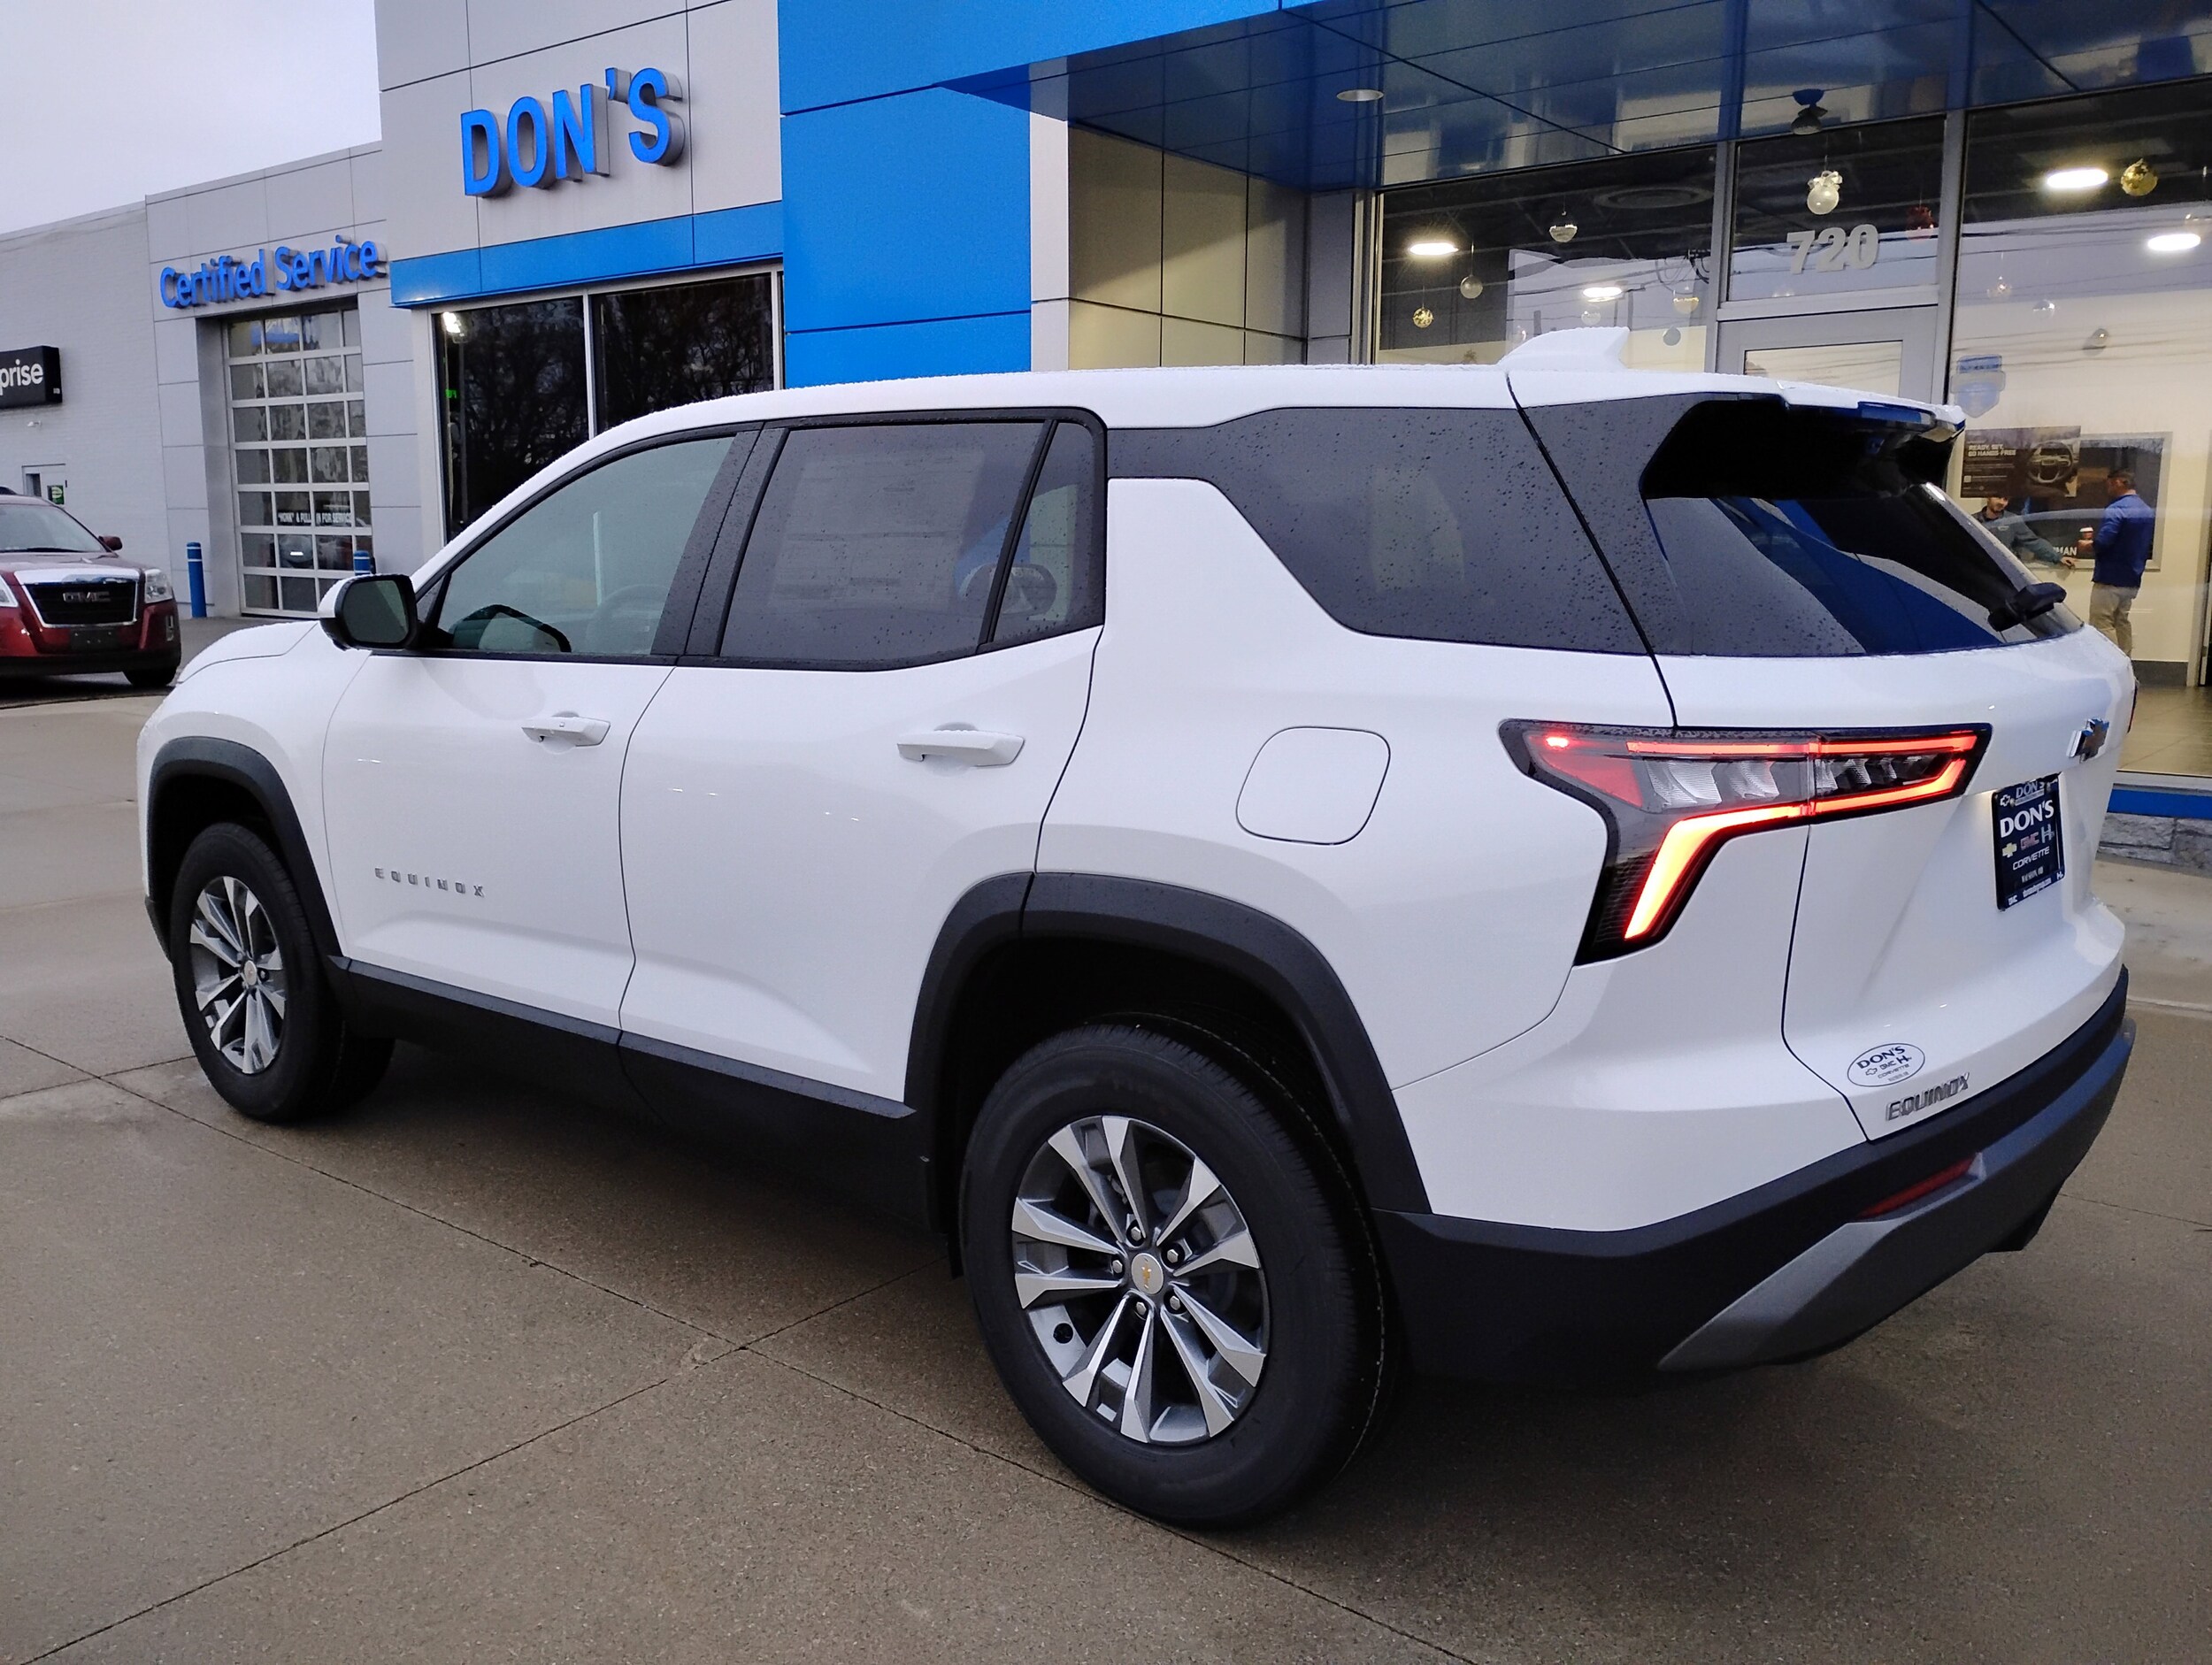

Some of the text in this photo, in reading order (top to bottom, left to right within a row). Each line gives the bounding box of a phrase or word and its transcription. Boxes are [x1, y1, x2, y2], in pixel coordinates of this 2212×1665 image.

[460, 67, 683, 196] DON'S
[1786, 224, 1879, 275] 720
[160, 234, 380, 308] Certified Service
[63, 591, 111, 602] GMC
[2000, 799, 2055, 838] DON'S
[2020, 832, 2039, 850] GMC
[2012, 846, 2050, 871] CORVETTE
[374, 867, 485, 898] EQUINOX
[1856, 1046, 1906, 1069] DON'S
[1879, 1060, 1896, 1070] GMC
[1886, 1071, 1970, 1121] EQUINOX
